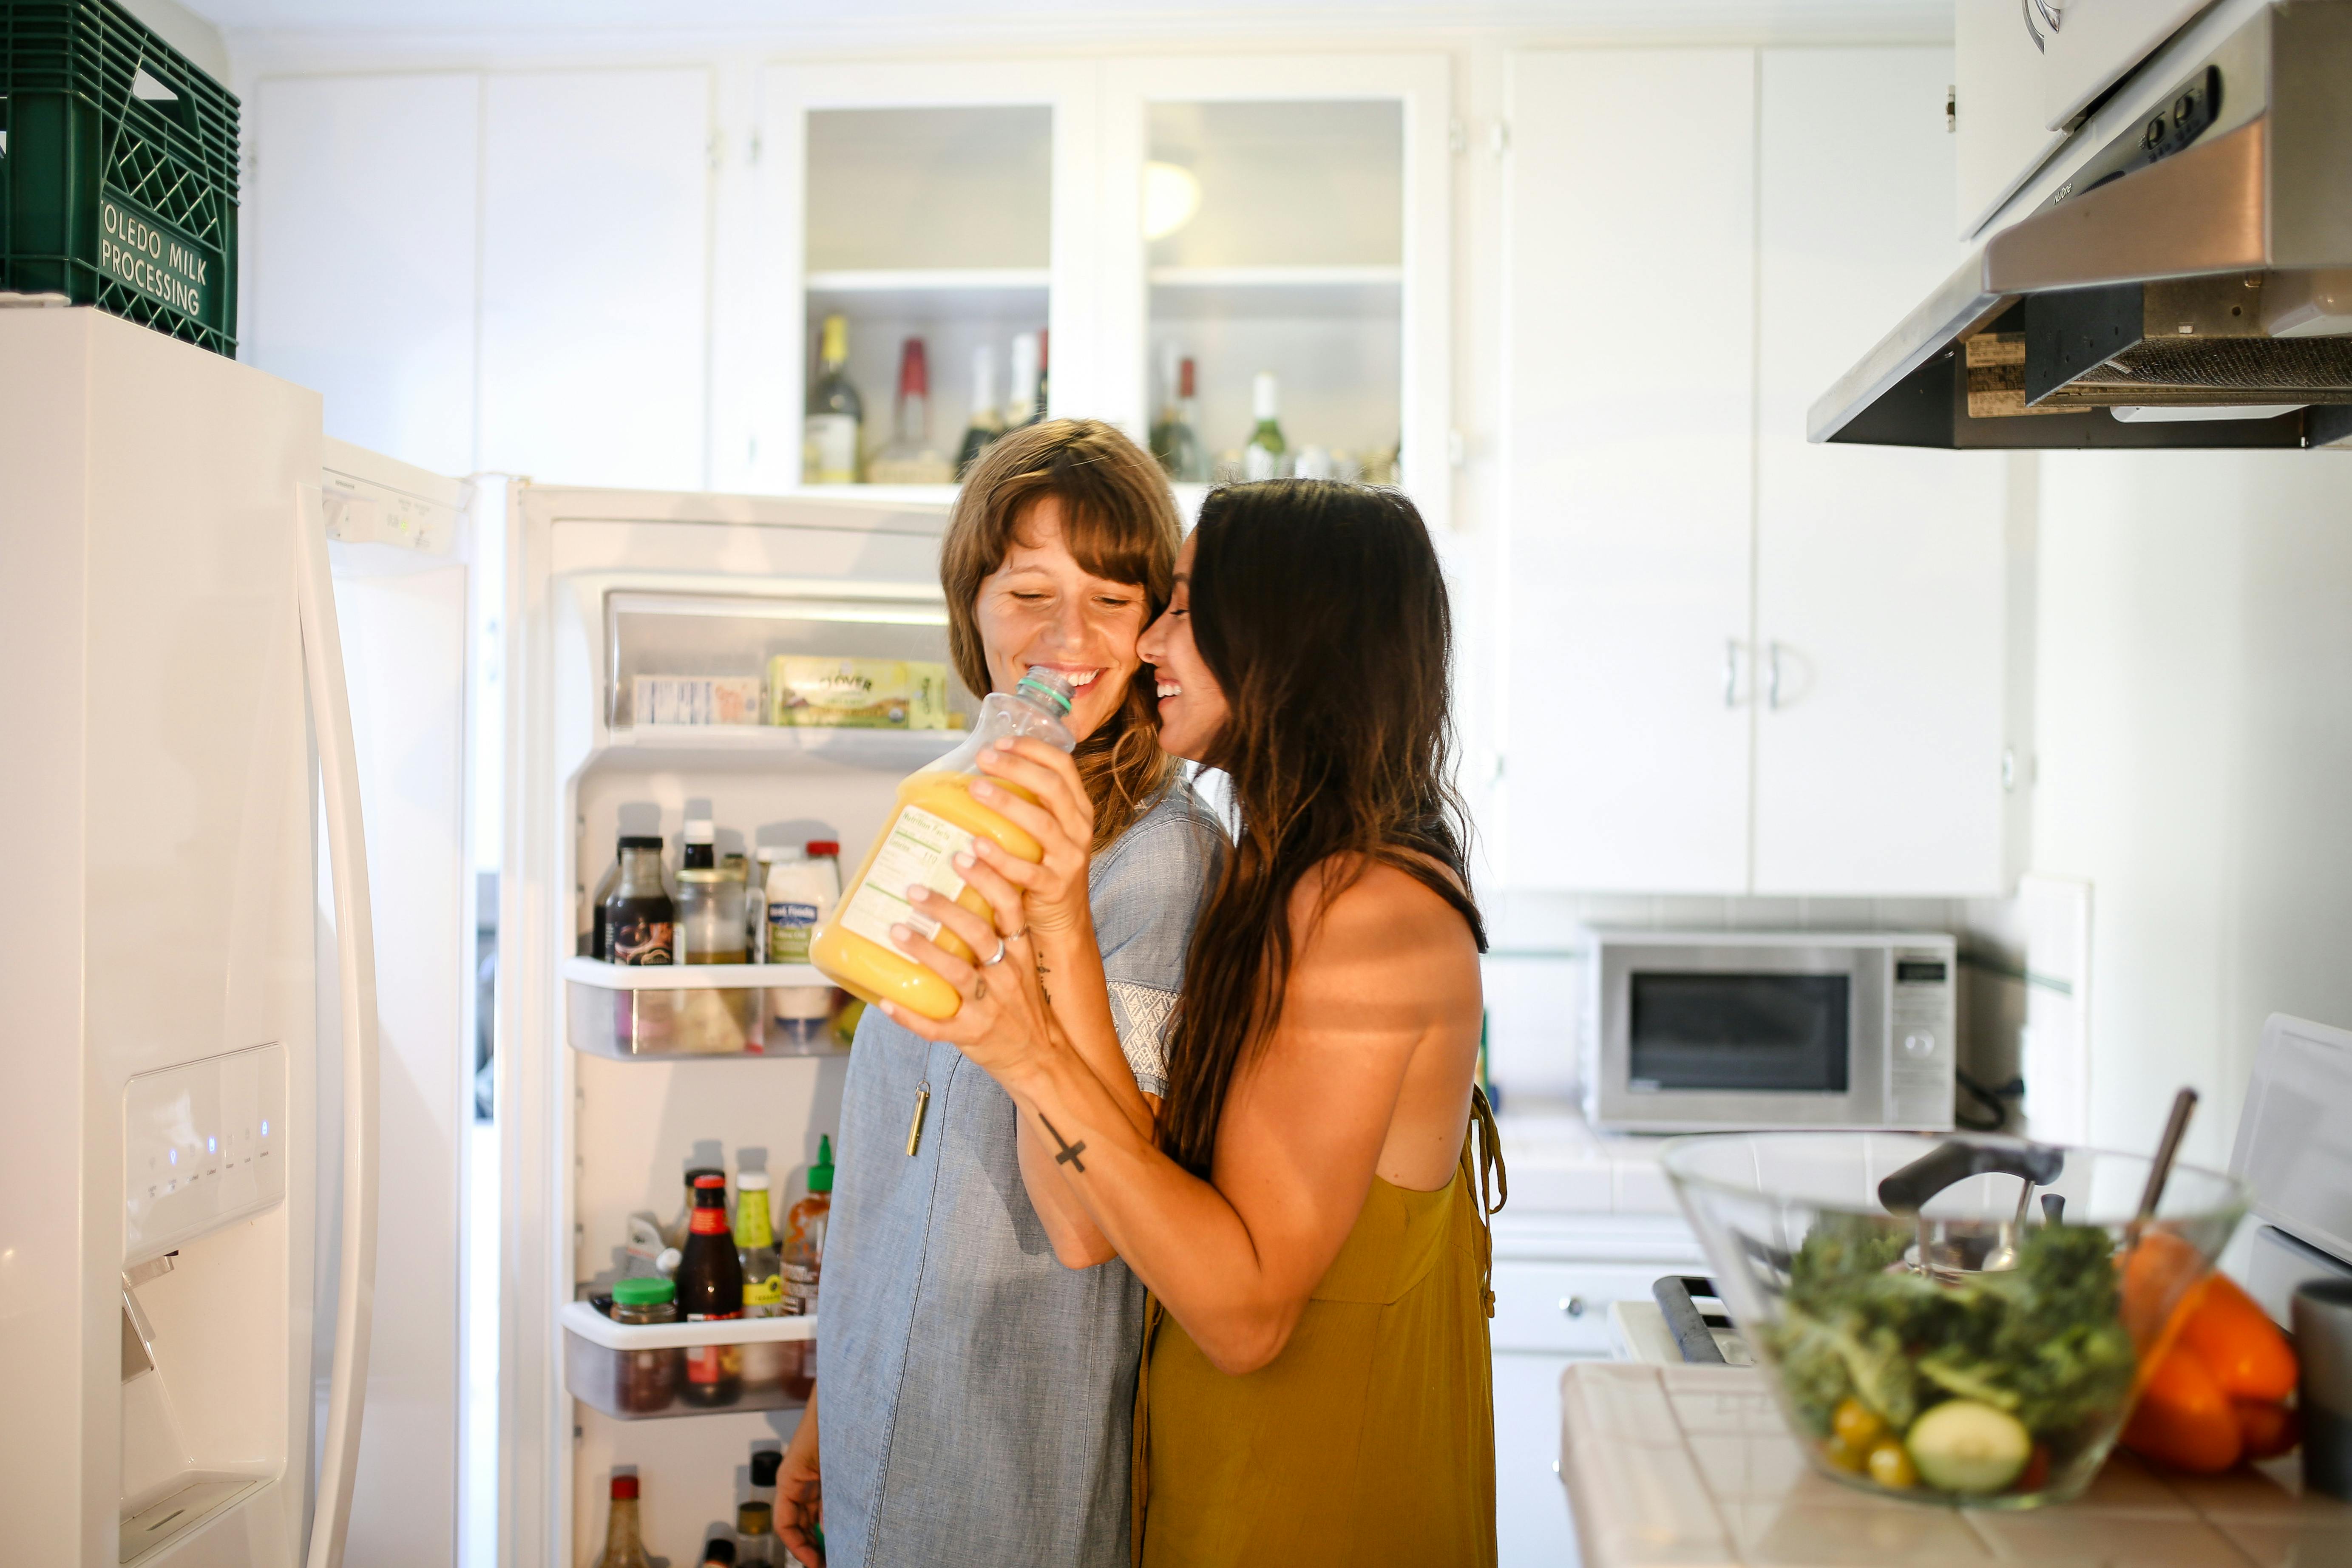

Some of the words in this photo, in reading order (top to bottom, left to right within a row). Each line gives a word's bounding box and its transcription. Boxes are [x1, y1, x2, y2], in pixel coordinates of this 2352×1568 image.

[102, 199, 161, 259] OLEDO
[169, 242, 207, 286] MILK
[102, 239, 199, 316] PROCESSING
[902, 811, 931, 829] Nutrition
